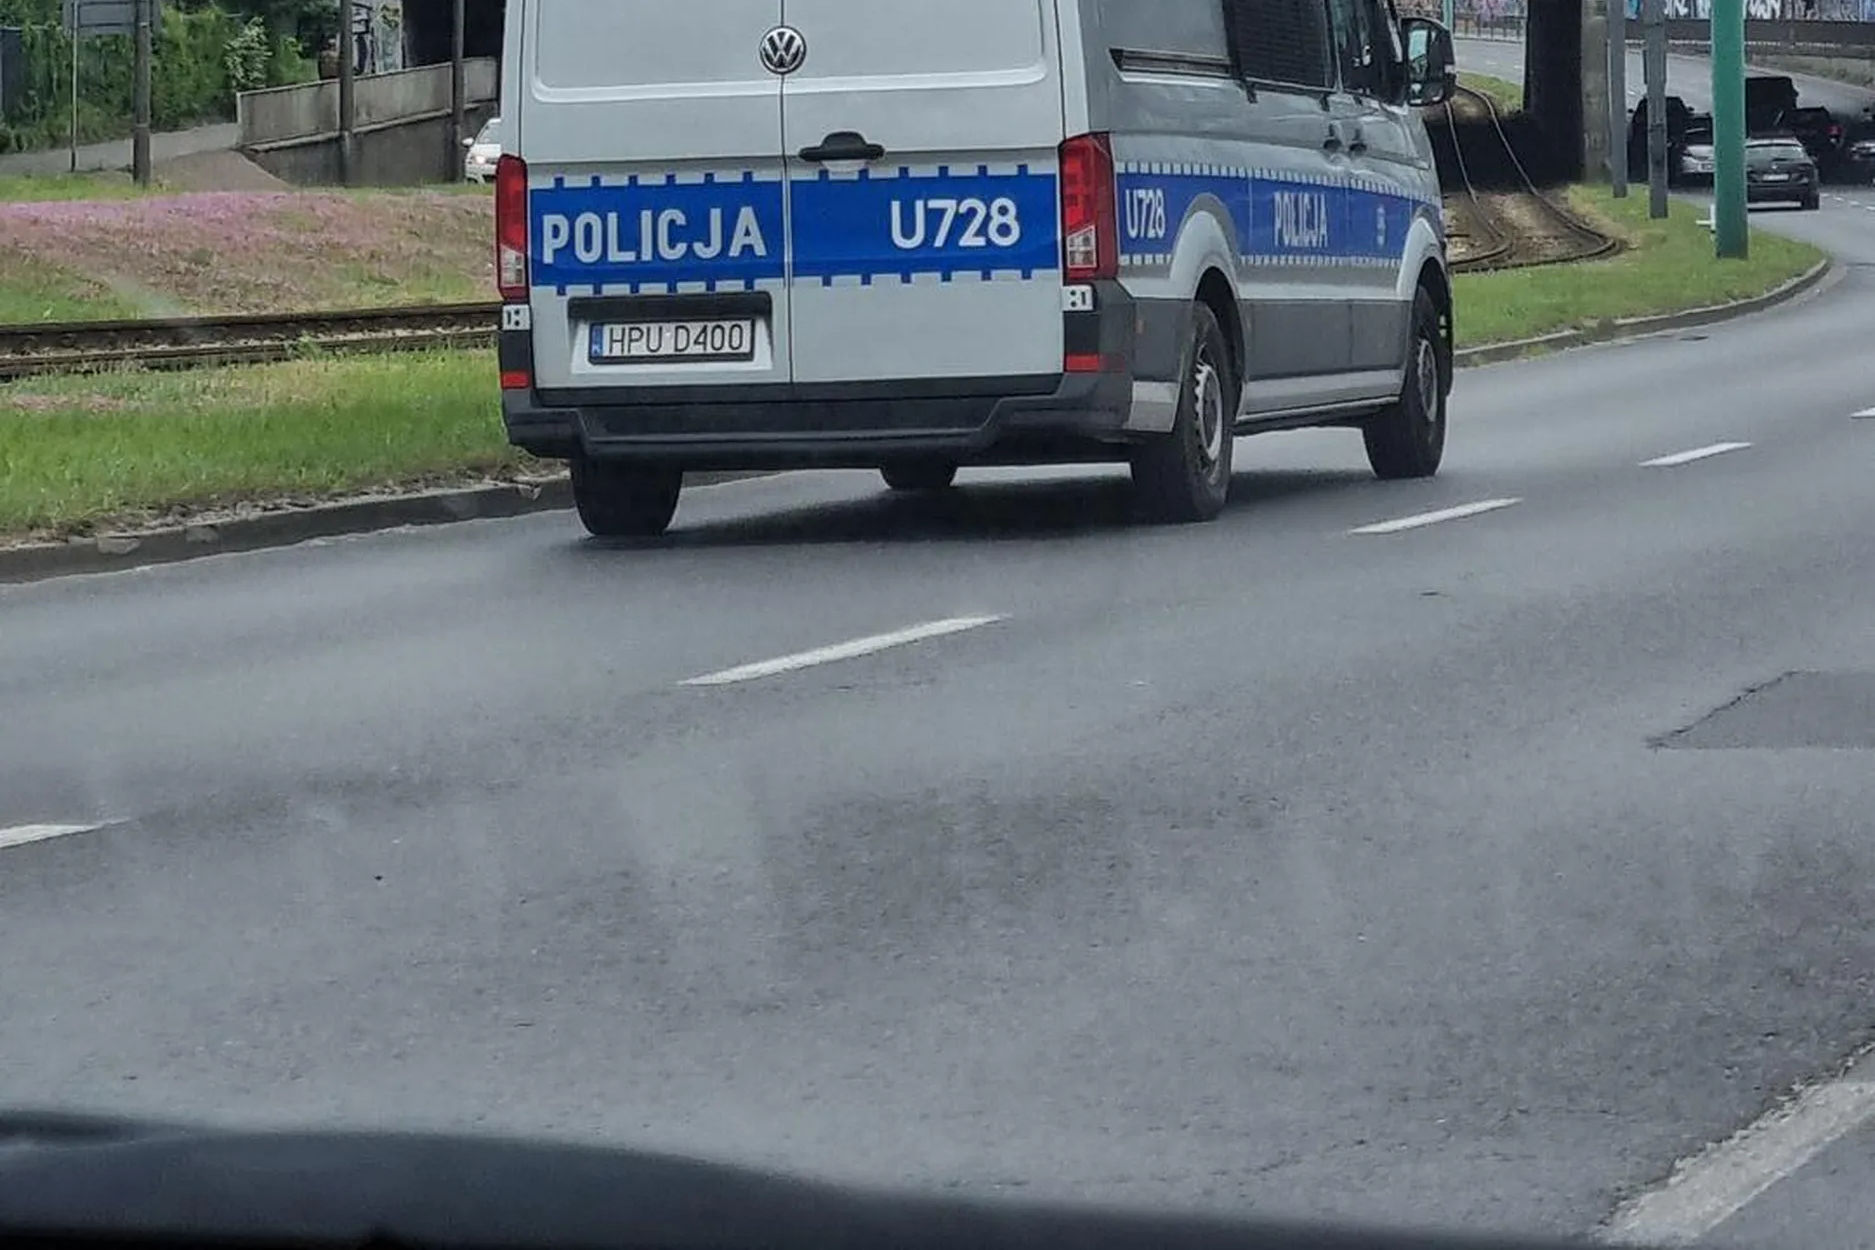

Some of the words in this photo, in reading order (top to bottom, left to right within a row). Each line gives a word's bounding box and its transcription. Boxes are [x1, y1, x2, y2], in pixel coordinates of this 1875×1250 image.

[542, 206, 767, 265] POLICJA
[890, 197, 1022, 250] U728
[1125, 188, 1166, 239] U728
[1274, 191, 1328, 248] POLICJA
[609, 326, 663, 355] HPU
[674, 323, 744, 353] D400
